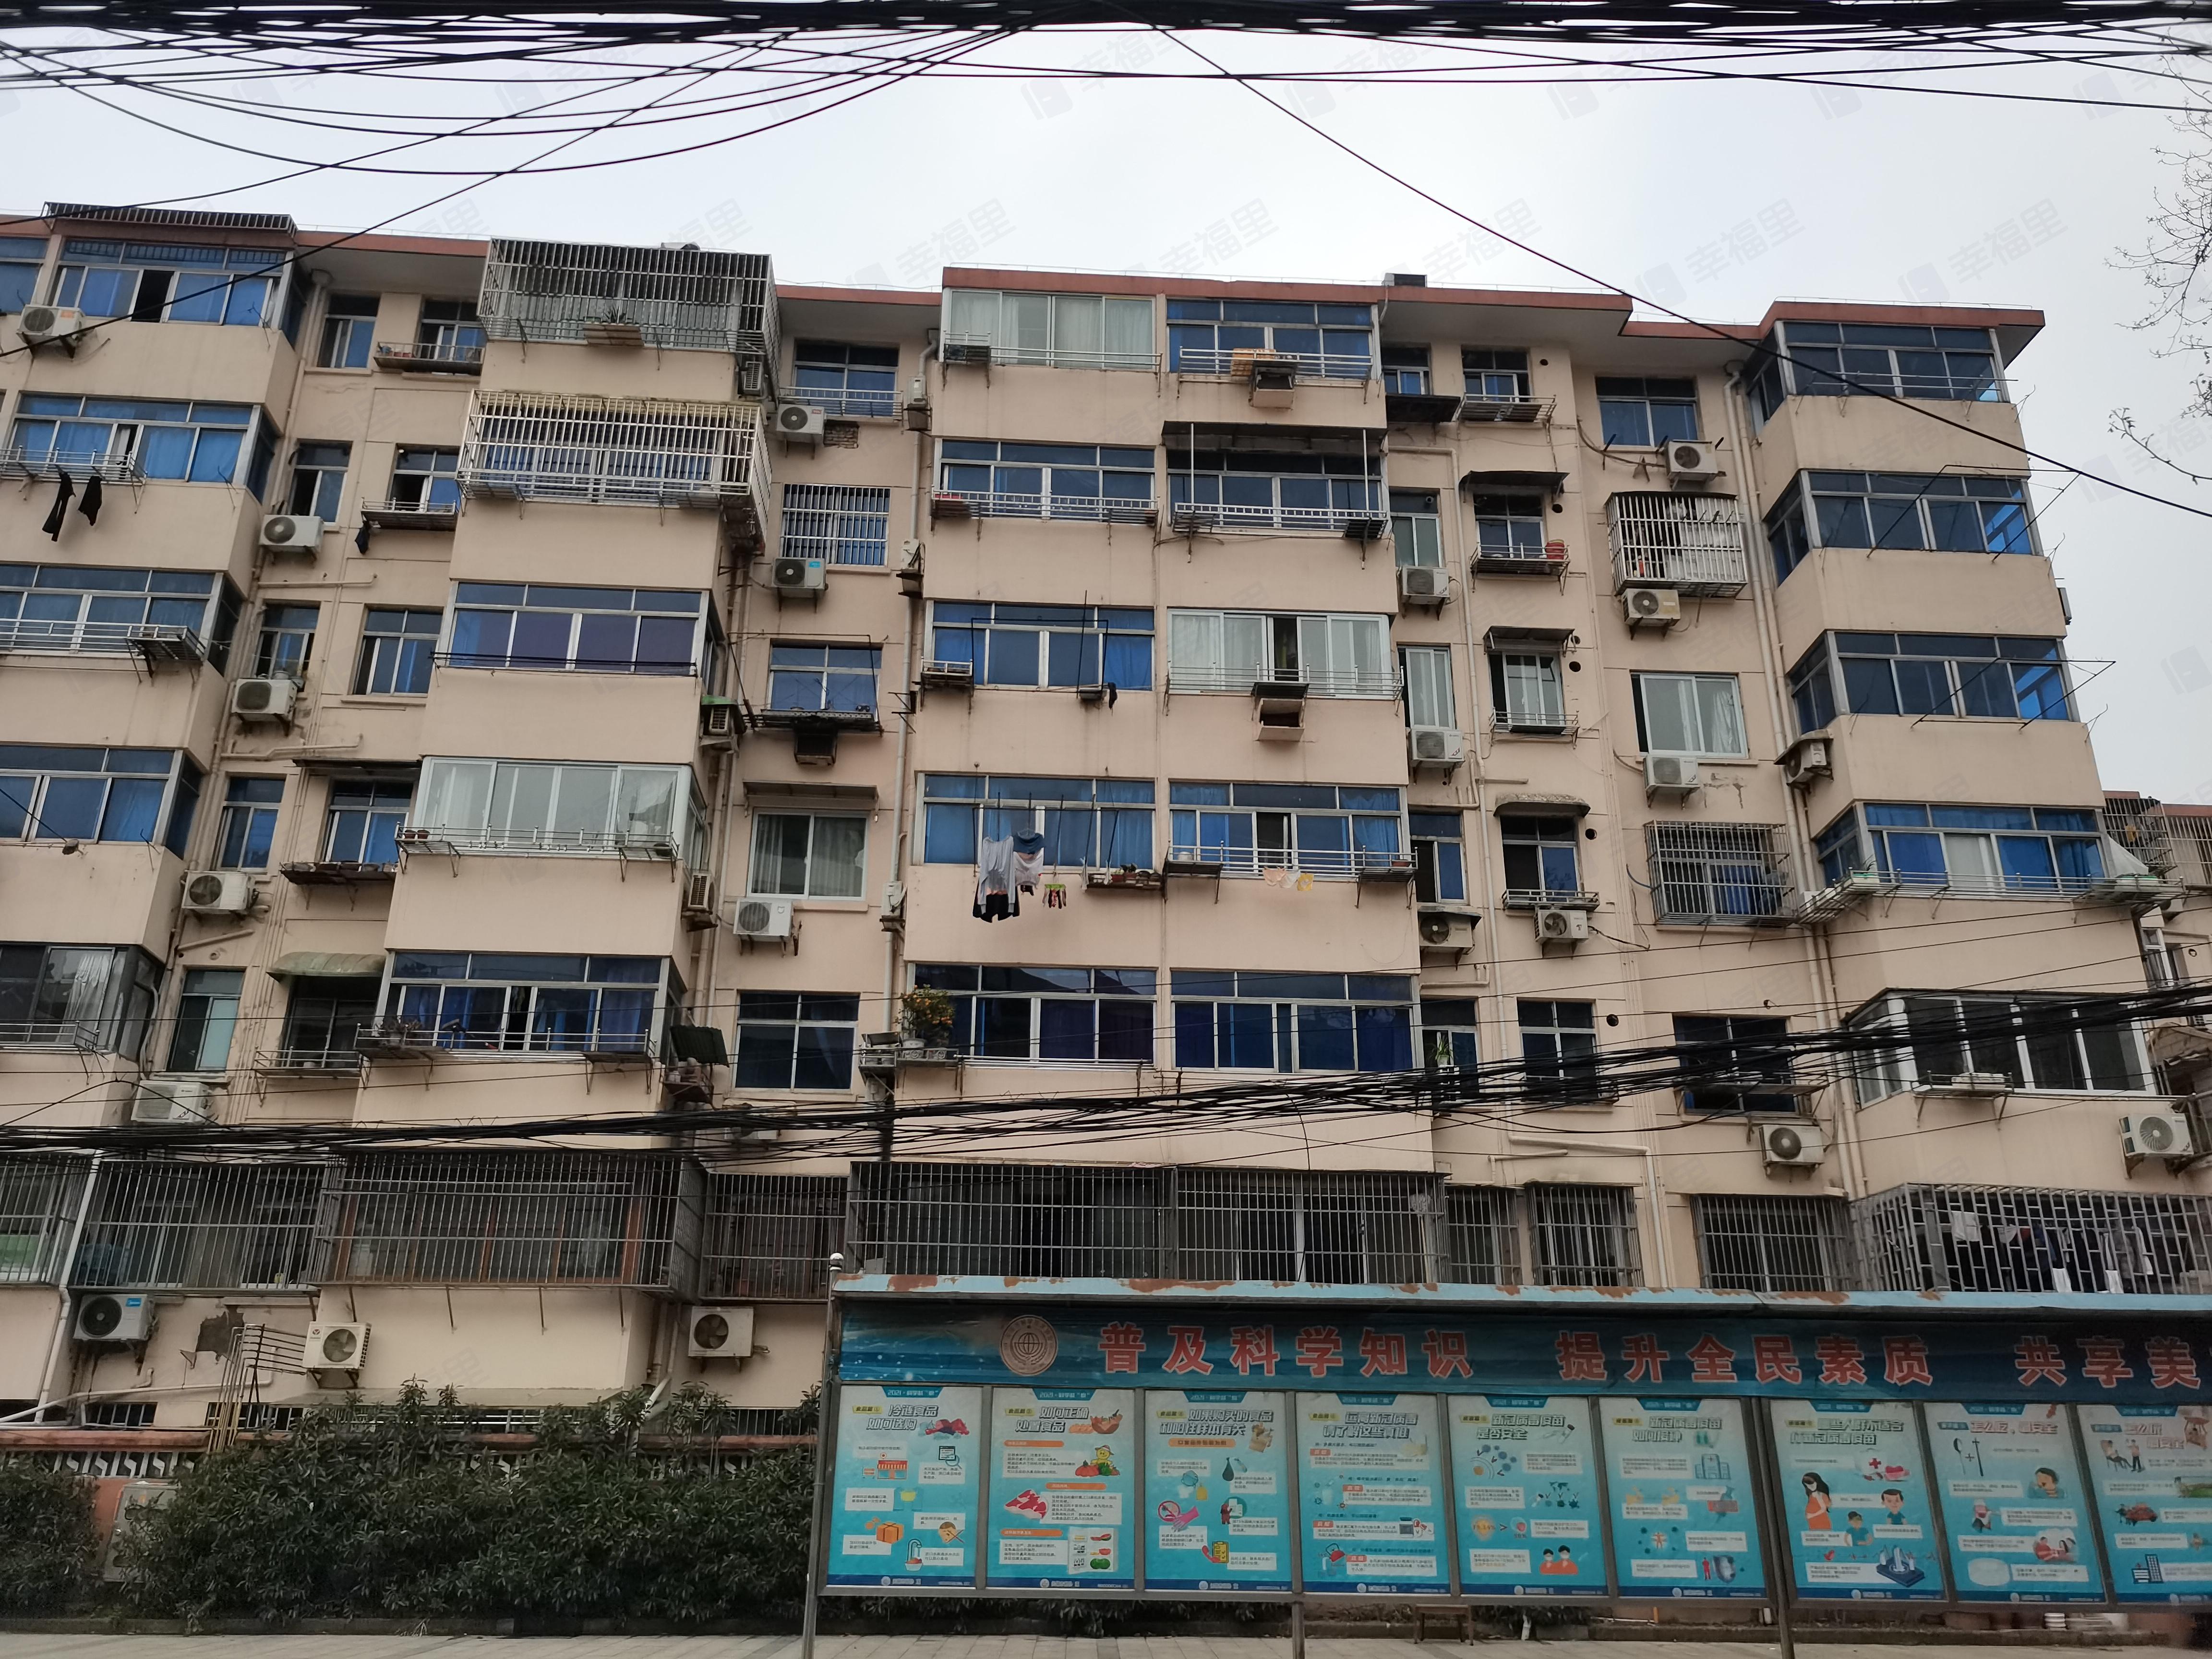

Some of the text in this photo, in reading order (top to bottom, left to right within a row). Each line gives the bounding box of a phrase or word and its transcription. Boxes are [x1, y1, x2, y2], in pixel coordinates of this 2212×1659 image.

[1097, 1322, 1474, 1379] 普及科学知识
[1555, 1330, 1933, 1386] 提升全民素质
[888, 1405, 939, 1417] 冷链食品
[1039, 1407, 1089, 1419] 如何正确
[1188, 1409, 1274, 1422] 如果购买的食品
[866, 1418, 917, 1430] 如何选购
[1491, 1413, 1565, 1427] 新冠病毒疫苗
[1477, 1427, 1528, 1440] 是否安全
[1632, 1430, 1682, 1443] 如何接种
